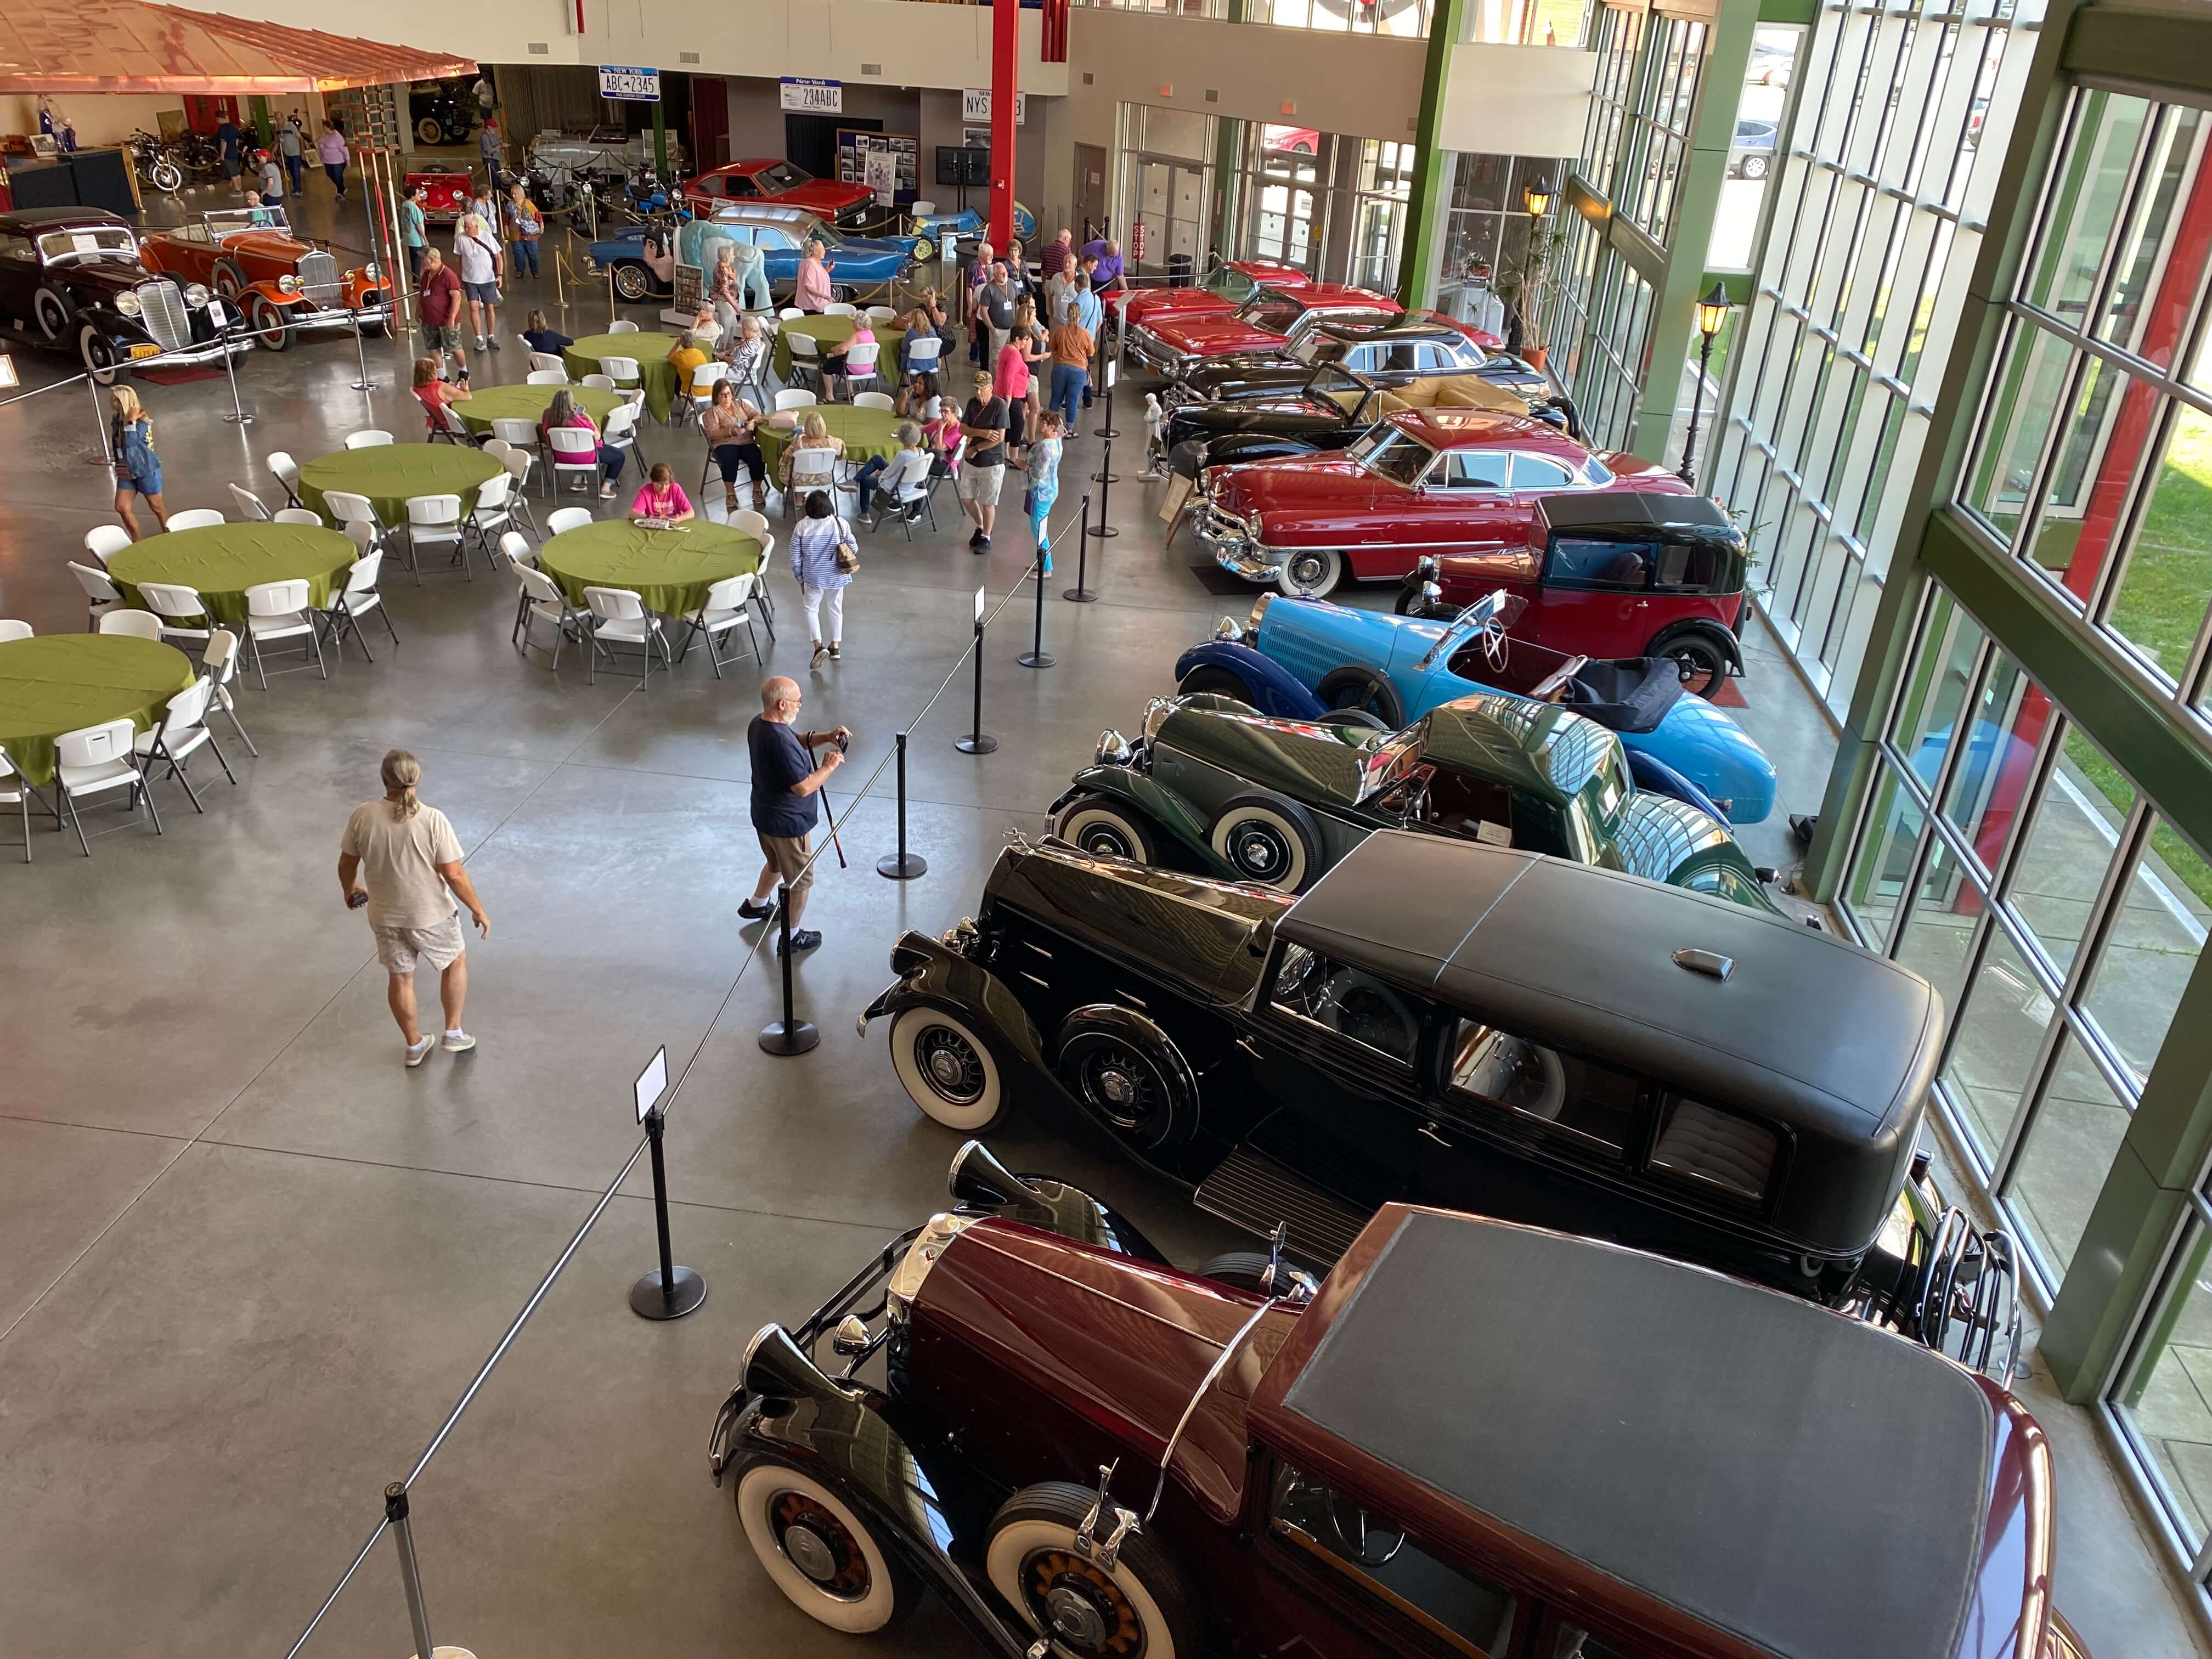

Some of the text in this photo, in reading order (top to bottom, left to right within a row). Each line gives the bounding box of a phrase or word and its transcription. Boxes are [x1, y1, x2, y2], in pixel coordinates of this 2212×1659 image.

[606, 75, 654, 93] ABC 2345
[804, 88, 837, 106] 234ABC
[967, 96, 988, 114] NYS
